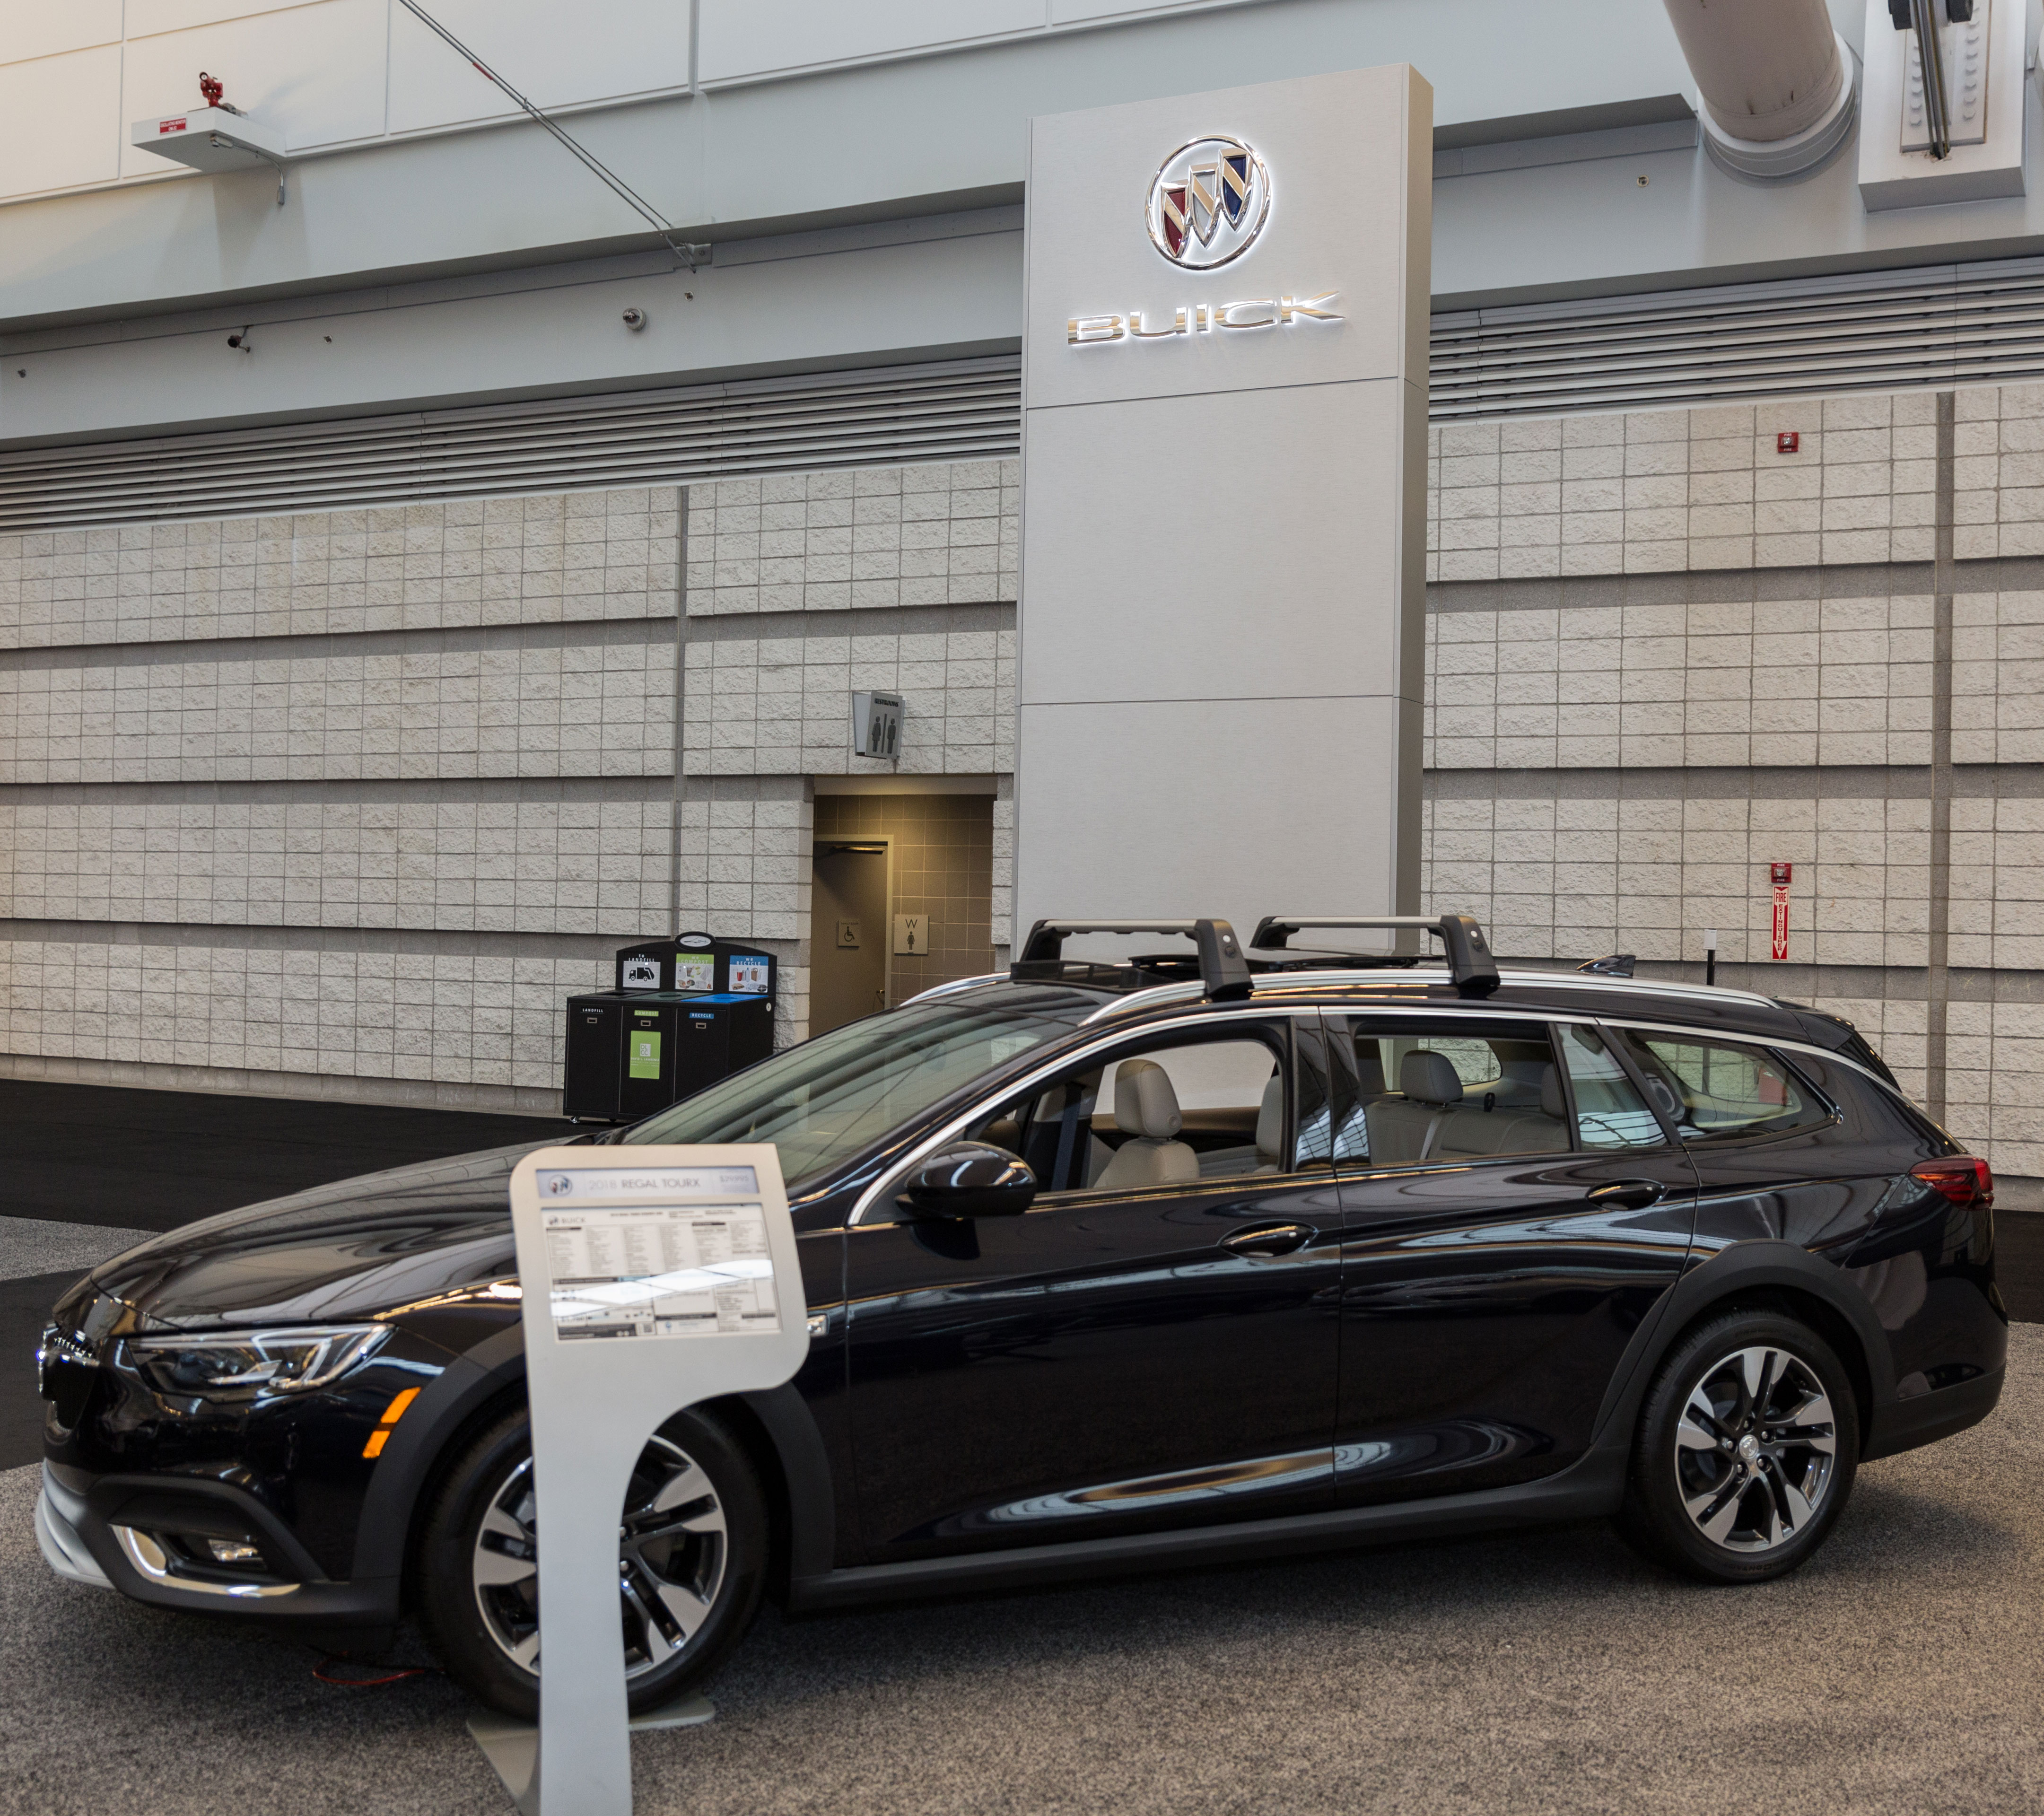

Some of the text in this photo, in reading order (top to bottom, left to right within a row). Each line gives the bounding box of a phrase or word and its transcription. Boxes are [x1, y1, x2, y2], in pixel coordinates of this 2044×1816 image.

[1067, 290, 1346, 346] BUICK
[874, 698, 899, 707] RESTROOMS
[1776, 892, 1786, 902] FIRE
[905, 919, 917, 928] W
[589, 1178, 701, 1189] 2018 REGAL TOURX
